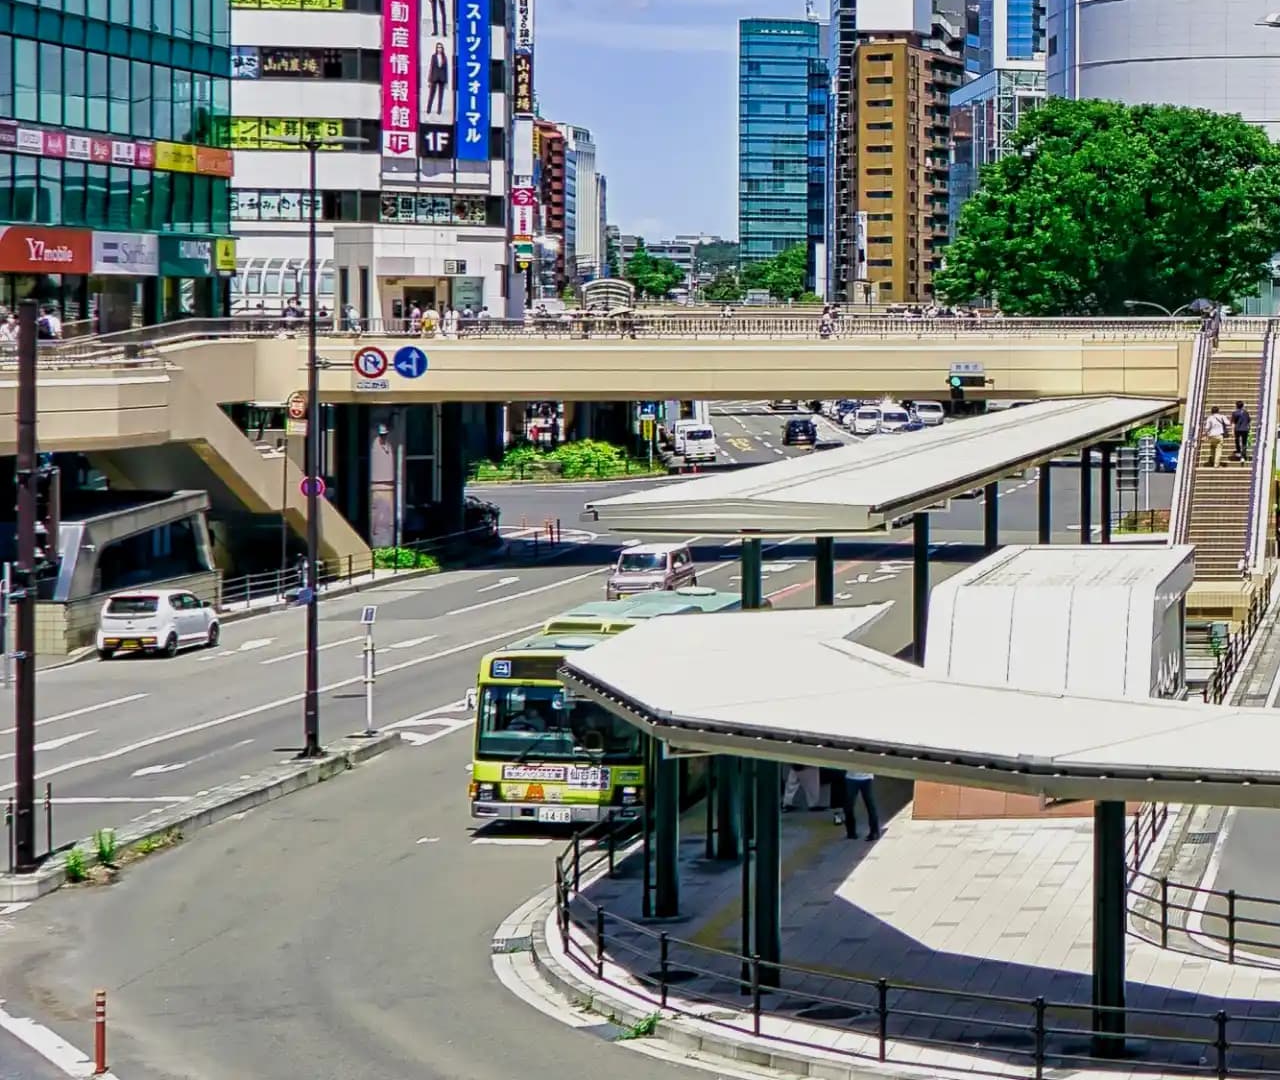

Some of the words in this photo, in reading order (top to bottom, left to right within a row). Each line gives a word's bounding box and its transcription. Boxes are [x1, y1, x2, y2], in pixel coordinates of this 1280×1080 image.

[464, 3, 481, 144] スーツ・フォーマル
[426, 132, 449, 151] 1F
